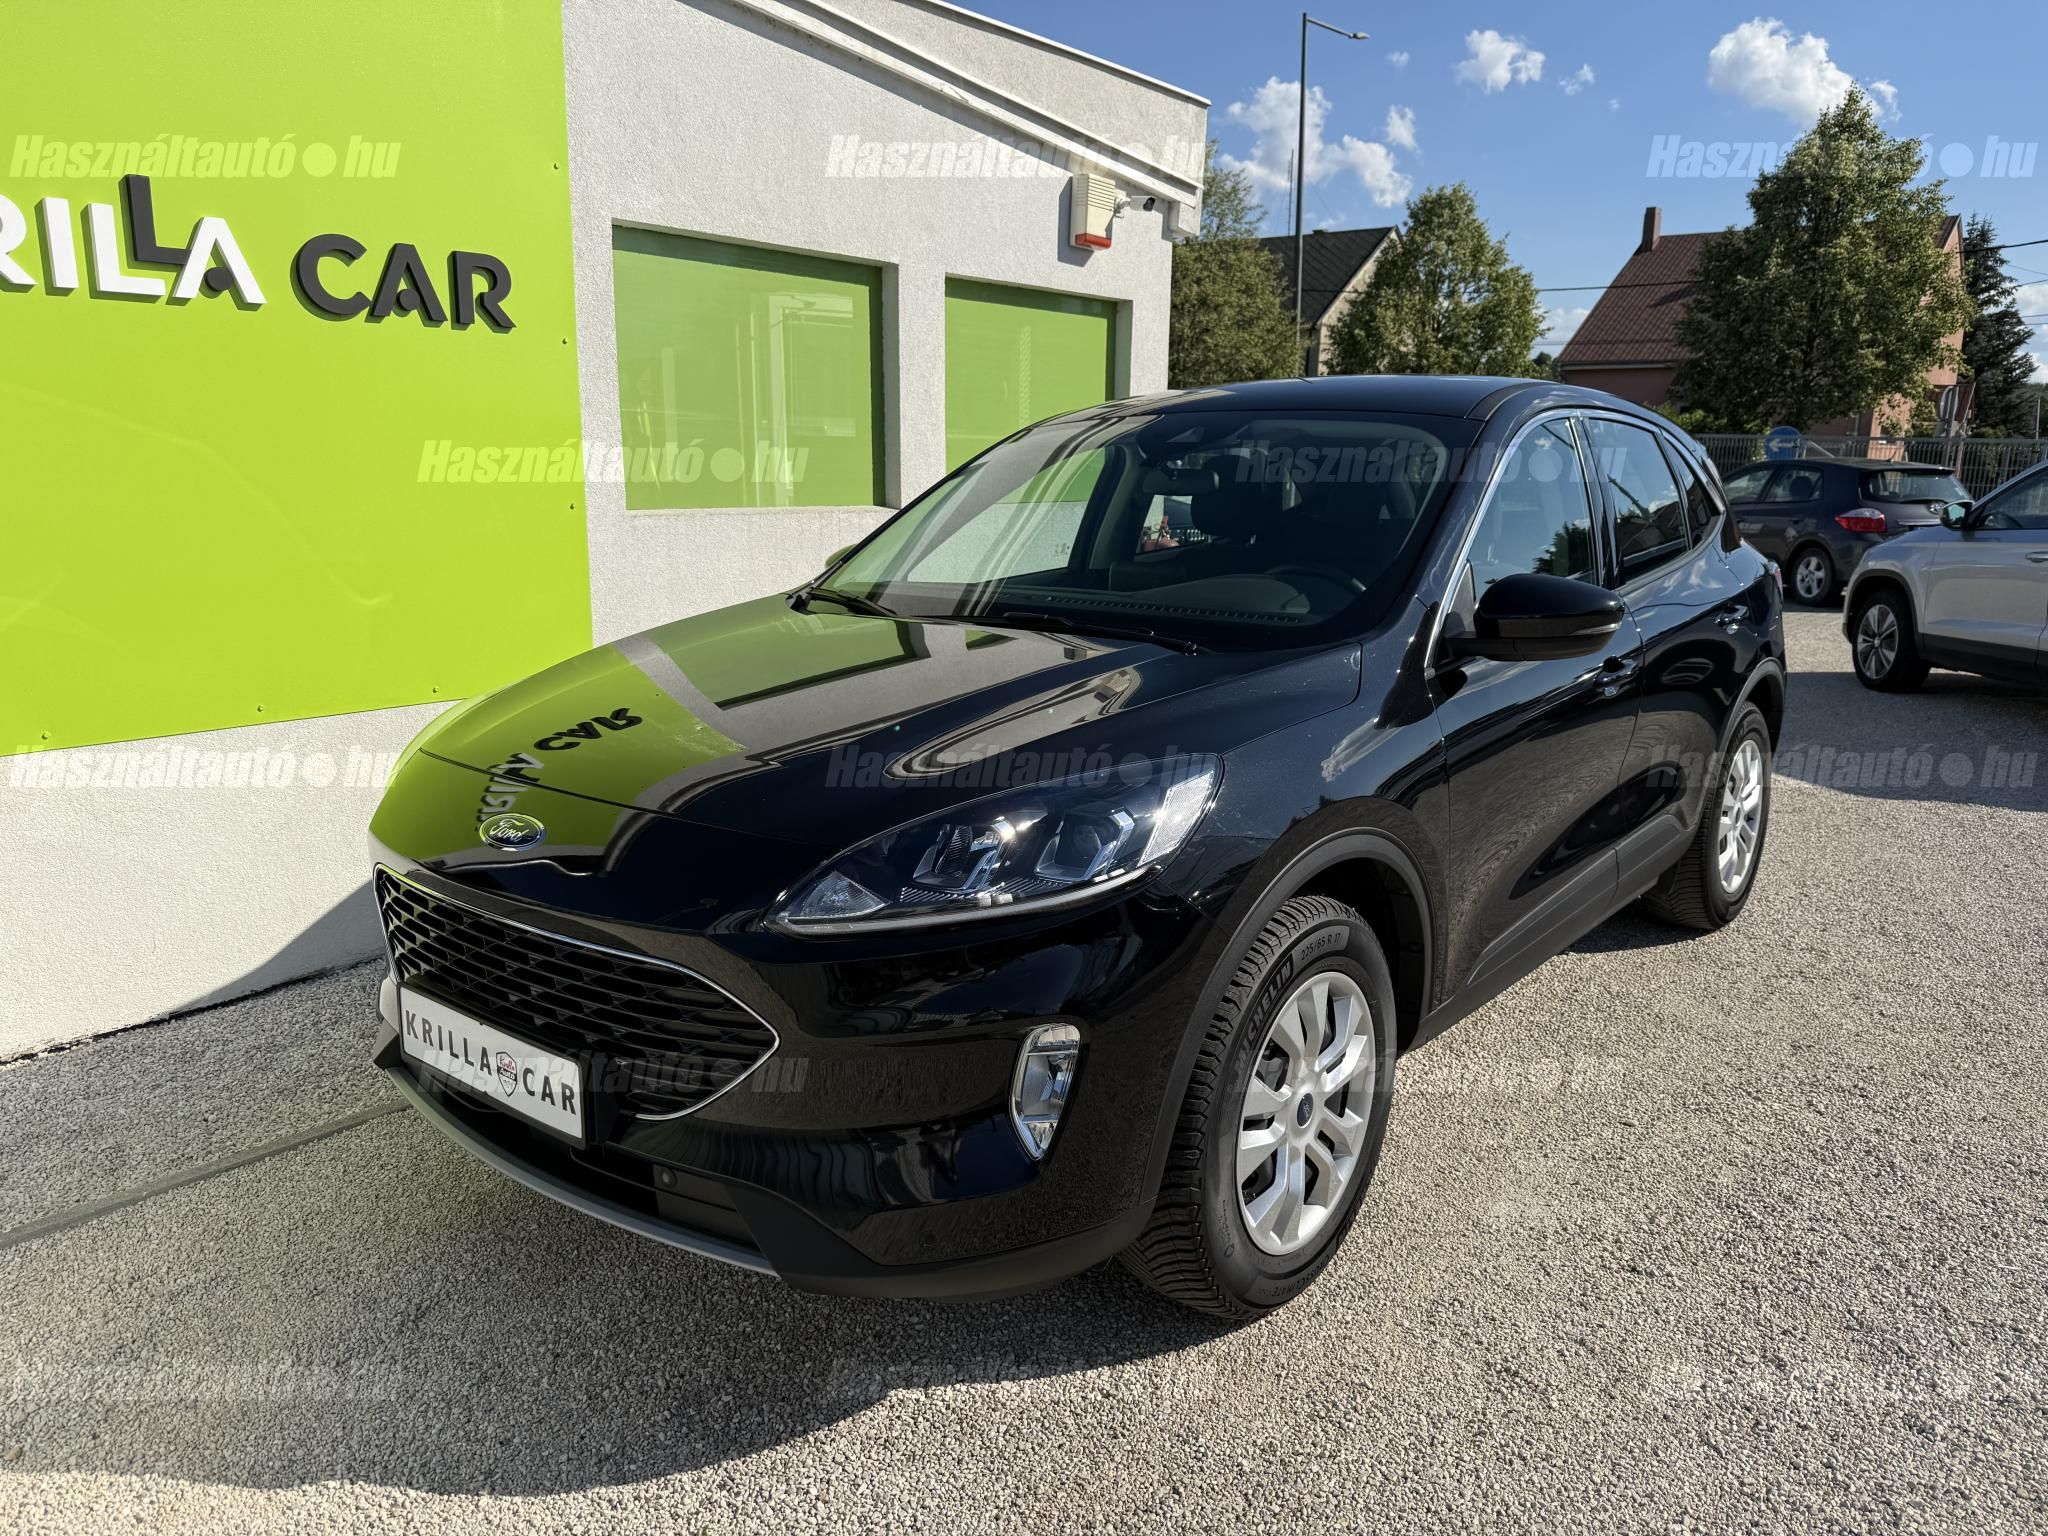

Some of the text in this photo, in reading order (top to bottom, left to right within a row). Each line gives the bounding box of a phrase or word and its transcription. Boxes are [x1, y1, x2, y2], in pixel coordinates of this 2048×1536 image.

[291, 234, 516, 331] CAR
[489, 818, 530, 842] Ford
[405, 1009, 576, 1115] KRILLA CAR
